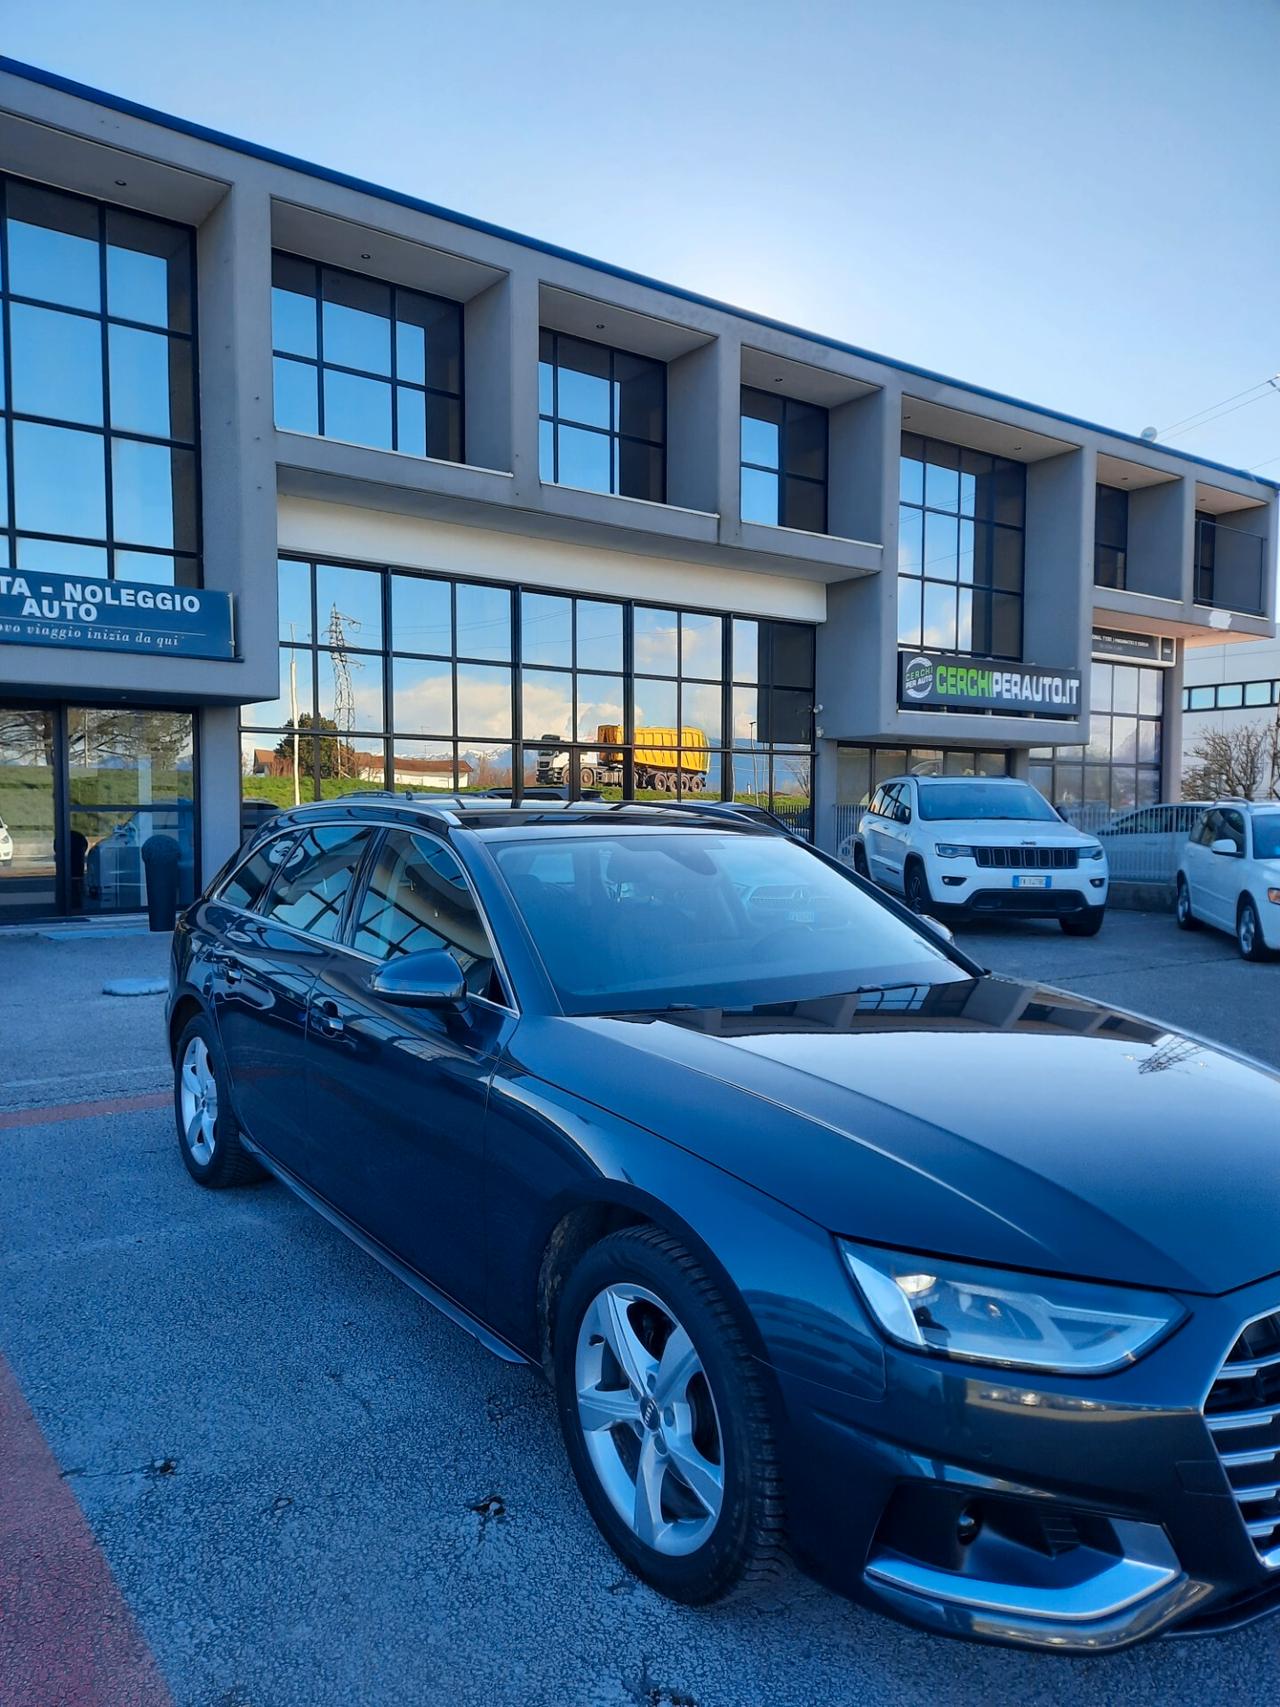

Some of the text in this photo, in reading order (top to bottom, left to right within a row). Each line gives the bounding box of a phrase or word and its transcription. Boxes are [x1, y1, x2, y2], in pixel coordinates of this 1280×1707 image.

[0, 575, 32, 597] TA
[64, 582, 201, 613] NOLEGGIO
[21, 598, 98, 622] AUTO
[0, 623, 178, 648] vo viaggio inizia da qui
[905, 666, 934, 682] CERCHI
[905, 675, 933, 689] PER AUTO
[936, 665, 1080, 704] CERCHIPERAUTO.IT
